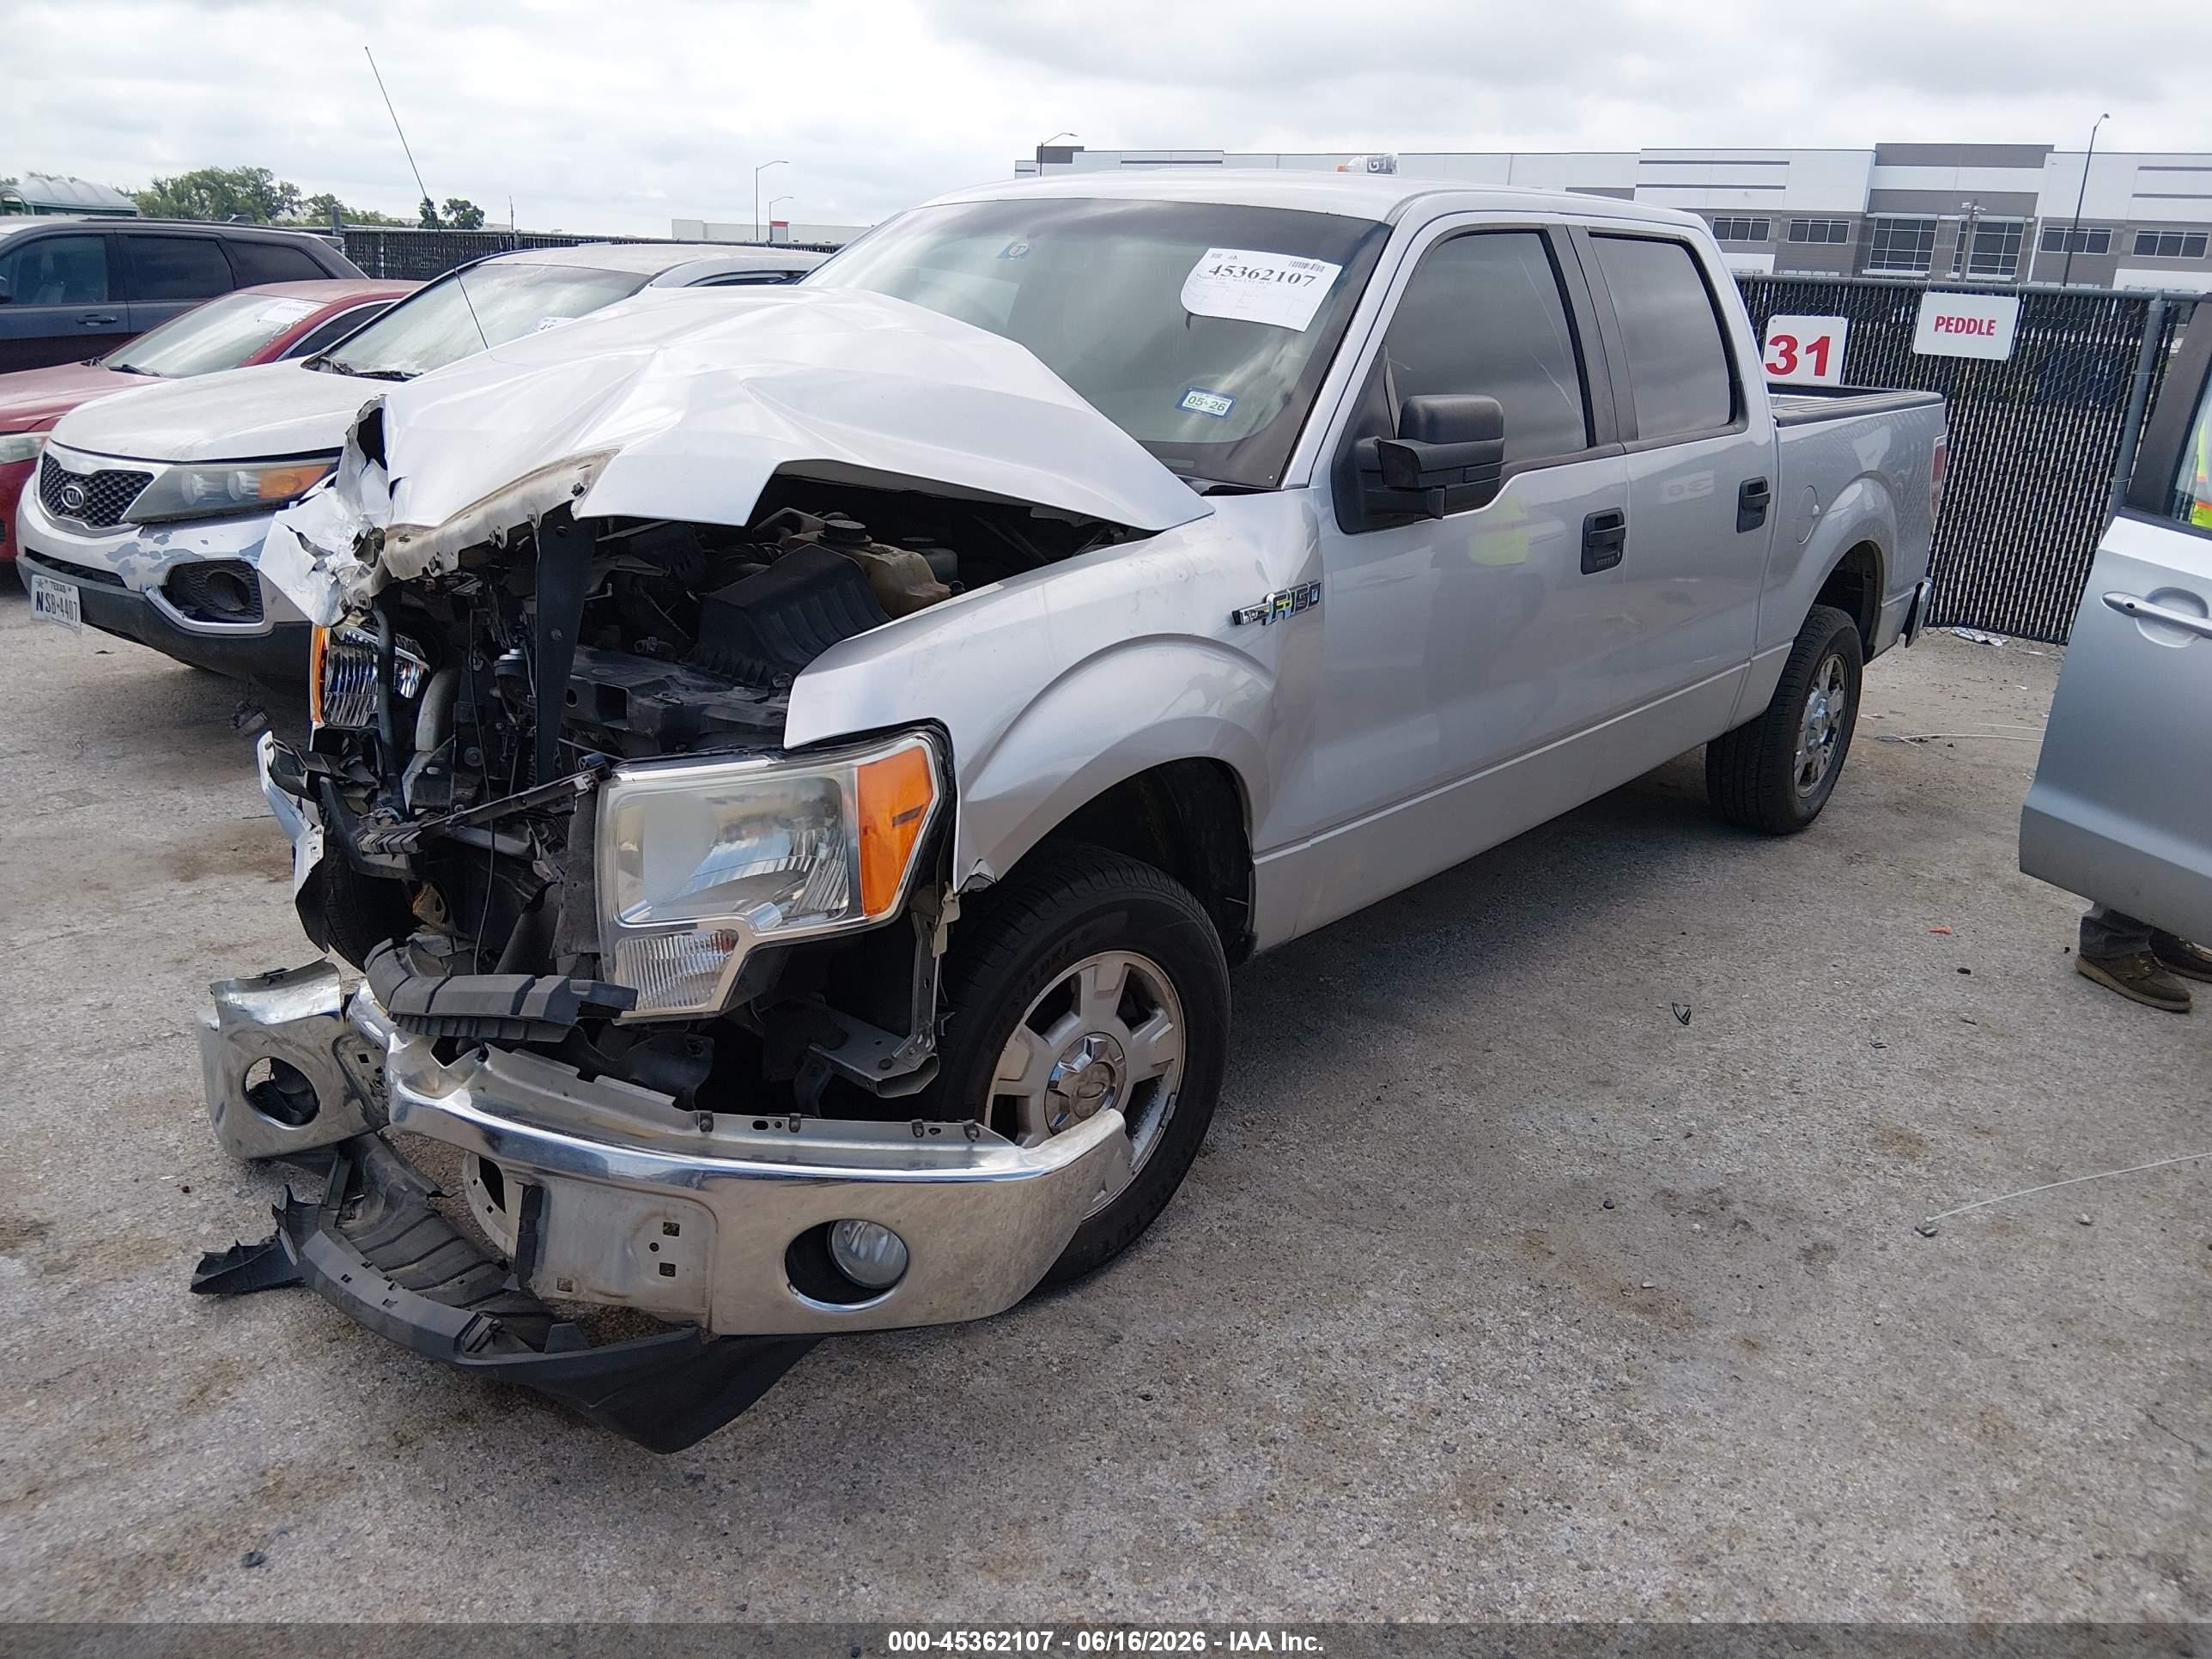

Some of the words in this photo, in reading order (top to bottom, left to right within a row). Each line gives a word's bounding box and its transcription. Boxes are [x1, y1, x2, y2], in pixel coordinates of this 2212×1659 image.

[1208, 264, 1317, 288] 45362107
[1933, 315, 1996, 337] PEDDLE
[1765, 333, 1832, 378] 31
